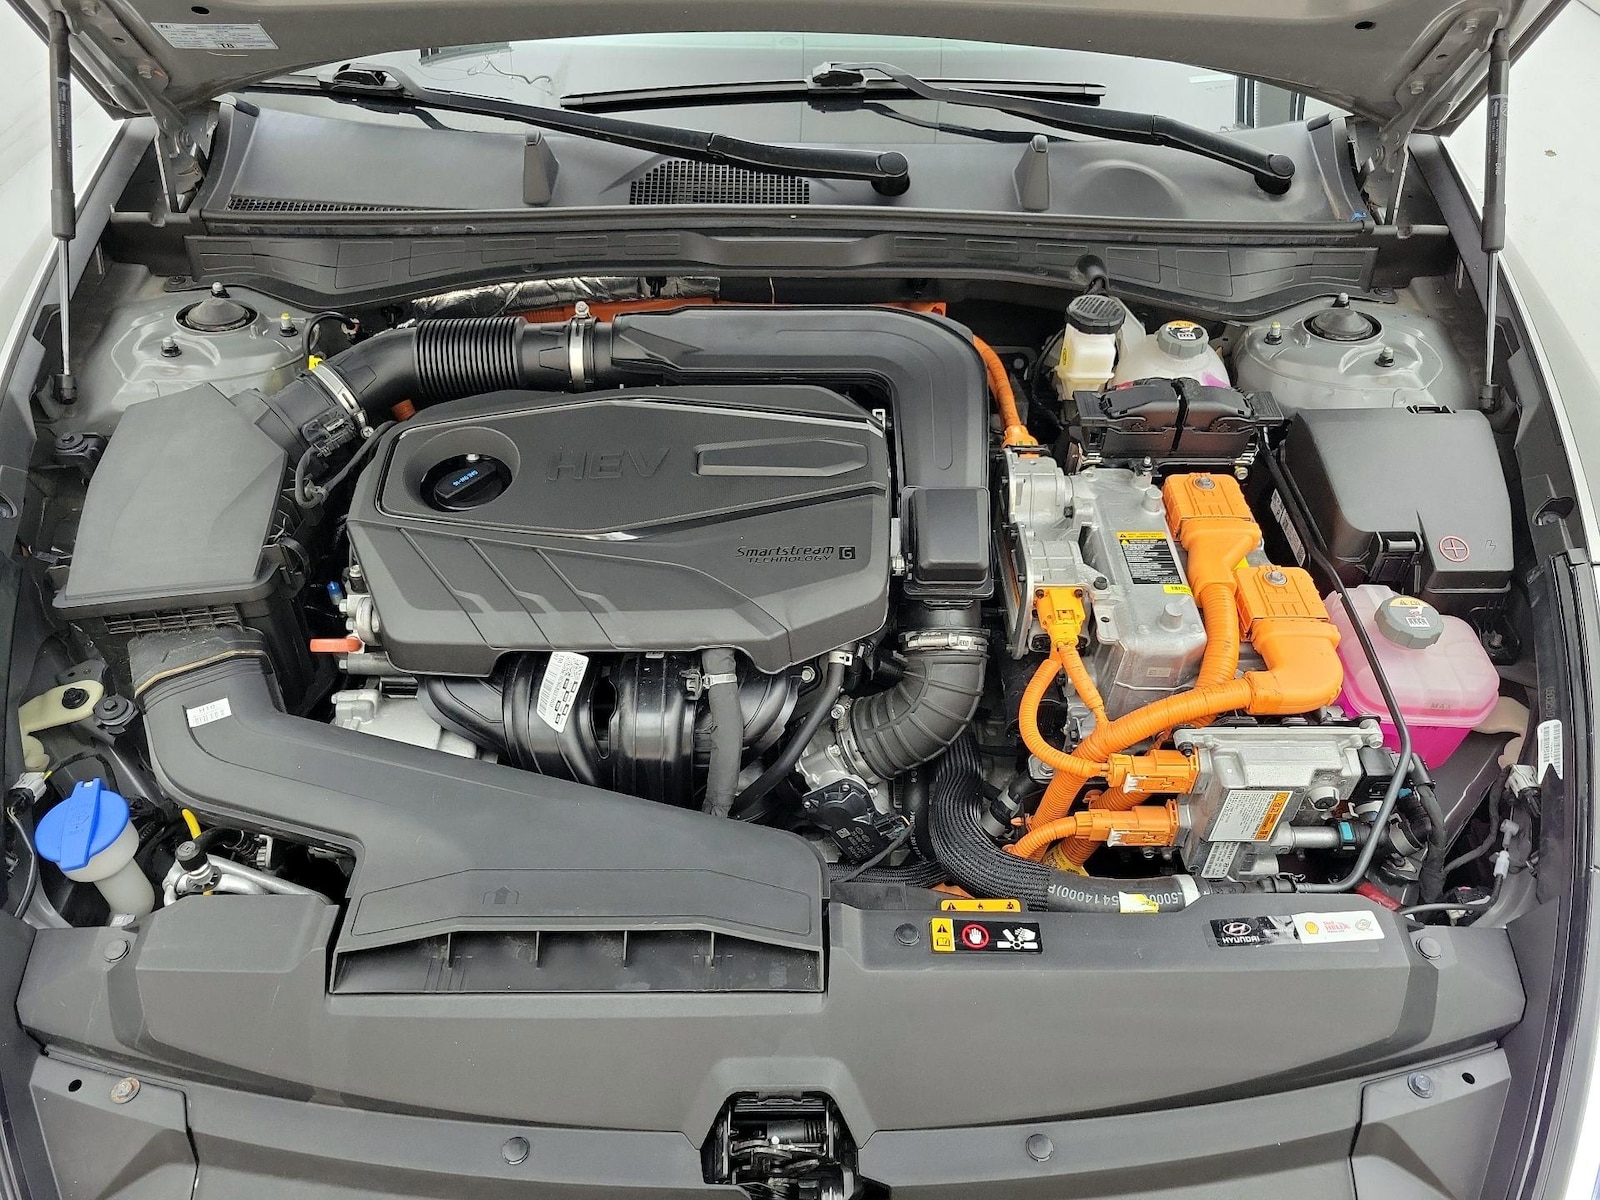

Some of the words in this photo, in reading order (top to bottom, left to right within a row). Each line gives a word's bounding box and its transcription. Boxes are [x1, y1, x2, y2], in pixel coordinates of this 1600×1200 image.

[546, 446, 672, 481] HEV
[735, 545, 835, 558] Smartstream
[840, 546, 856, 560] G
[748, 555, 832, 564] TECHNOLOGY
[1222, 935, 1261, 944] HYUNDAI
